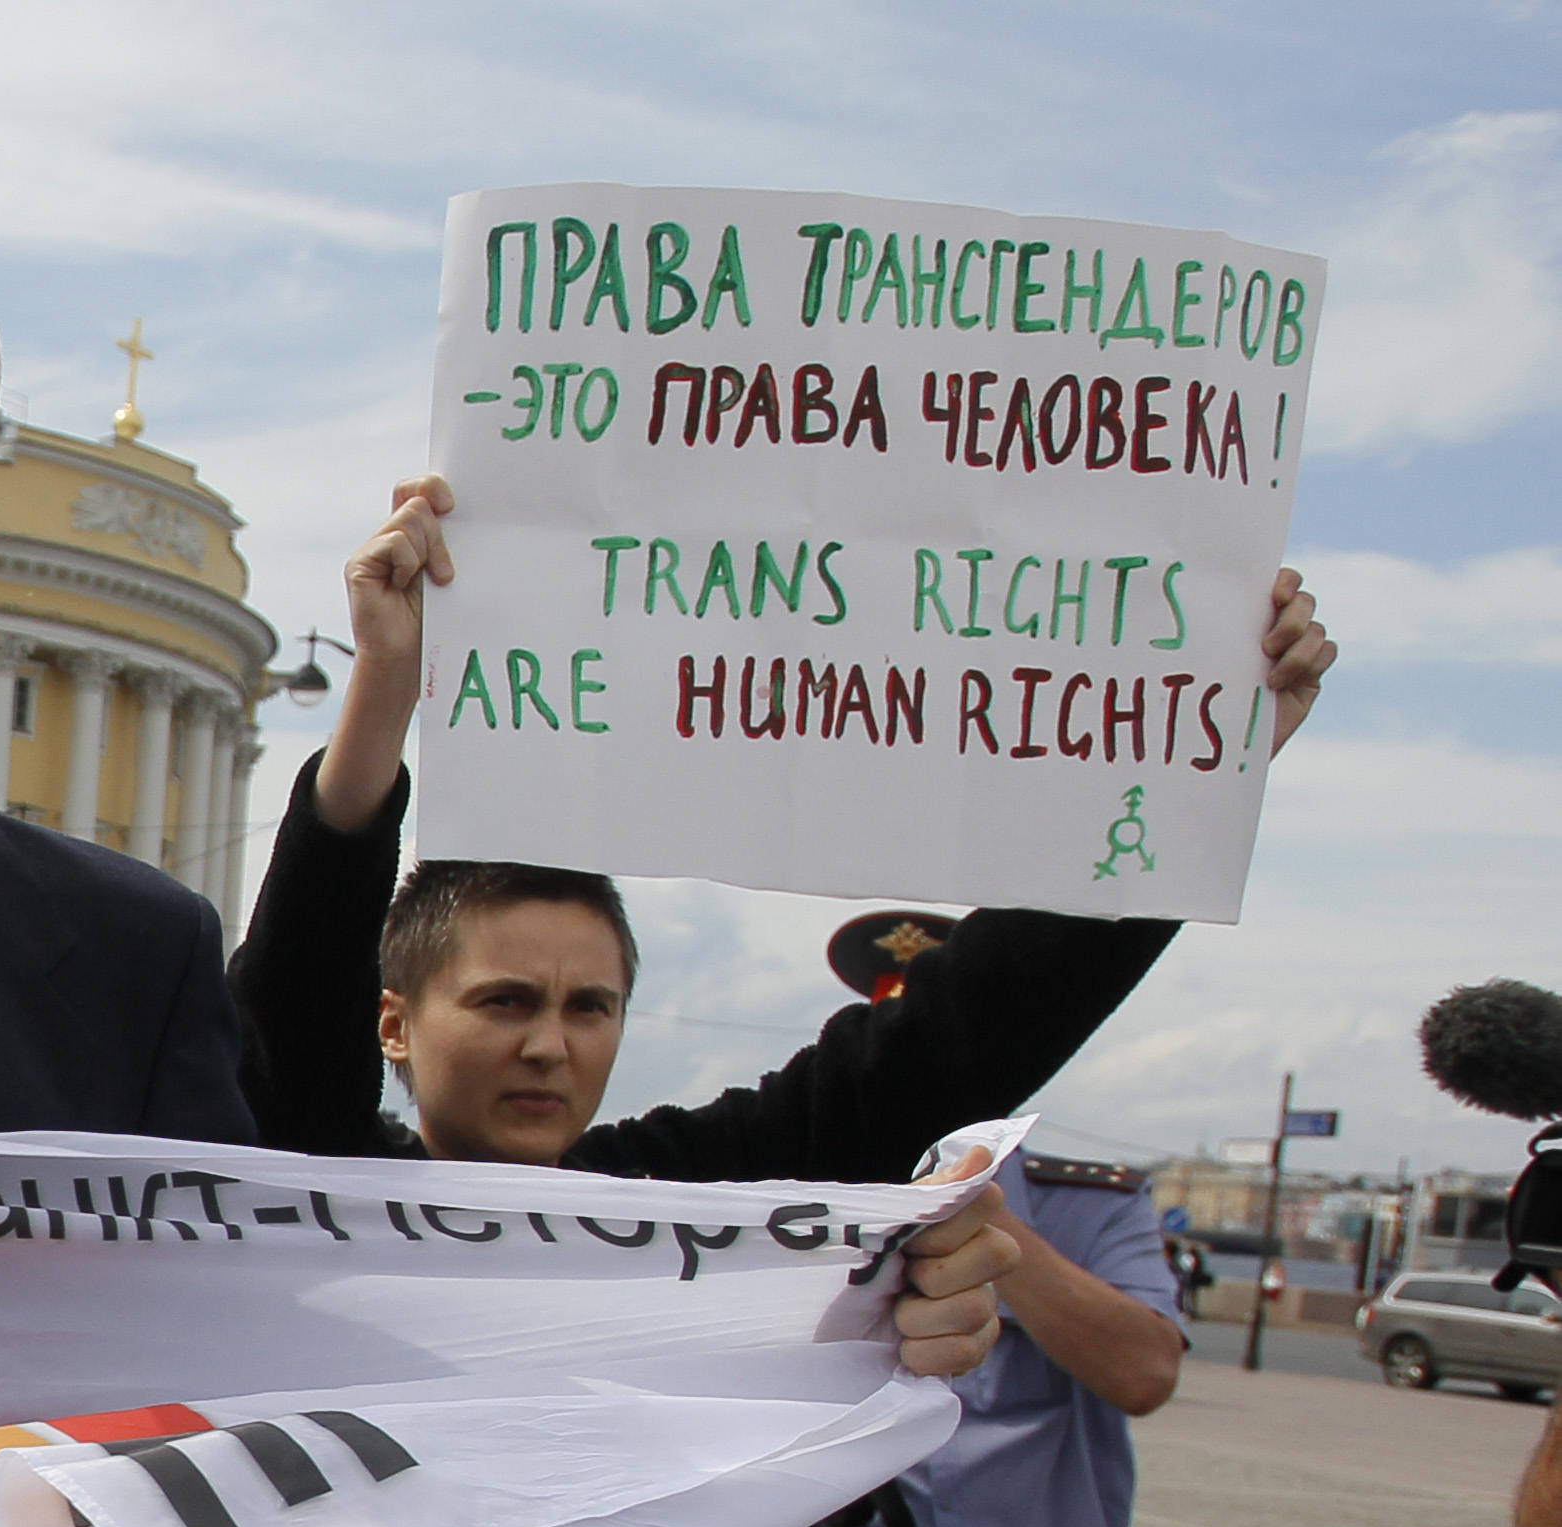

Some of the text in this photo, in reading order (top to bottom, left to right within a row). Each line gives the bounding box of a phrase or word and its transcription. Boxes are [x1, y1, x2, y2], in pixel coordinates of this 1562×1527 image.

[484, 216, 1307, 367] ПРАВА ТРАНСГЕНДЕРОВ
[647, 362, 889, 454] ПРАВА
[590, 535, 1187, 650] TRANS RIGHTS
[448, 647, 612, 735] ARE
[675, 653, 927, 747] HUMAN
[958, 665, 1263, 774] RIGHTS!
